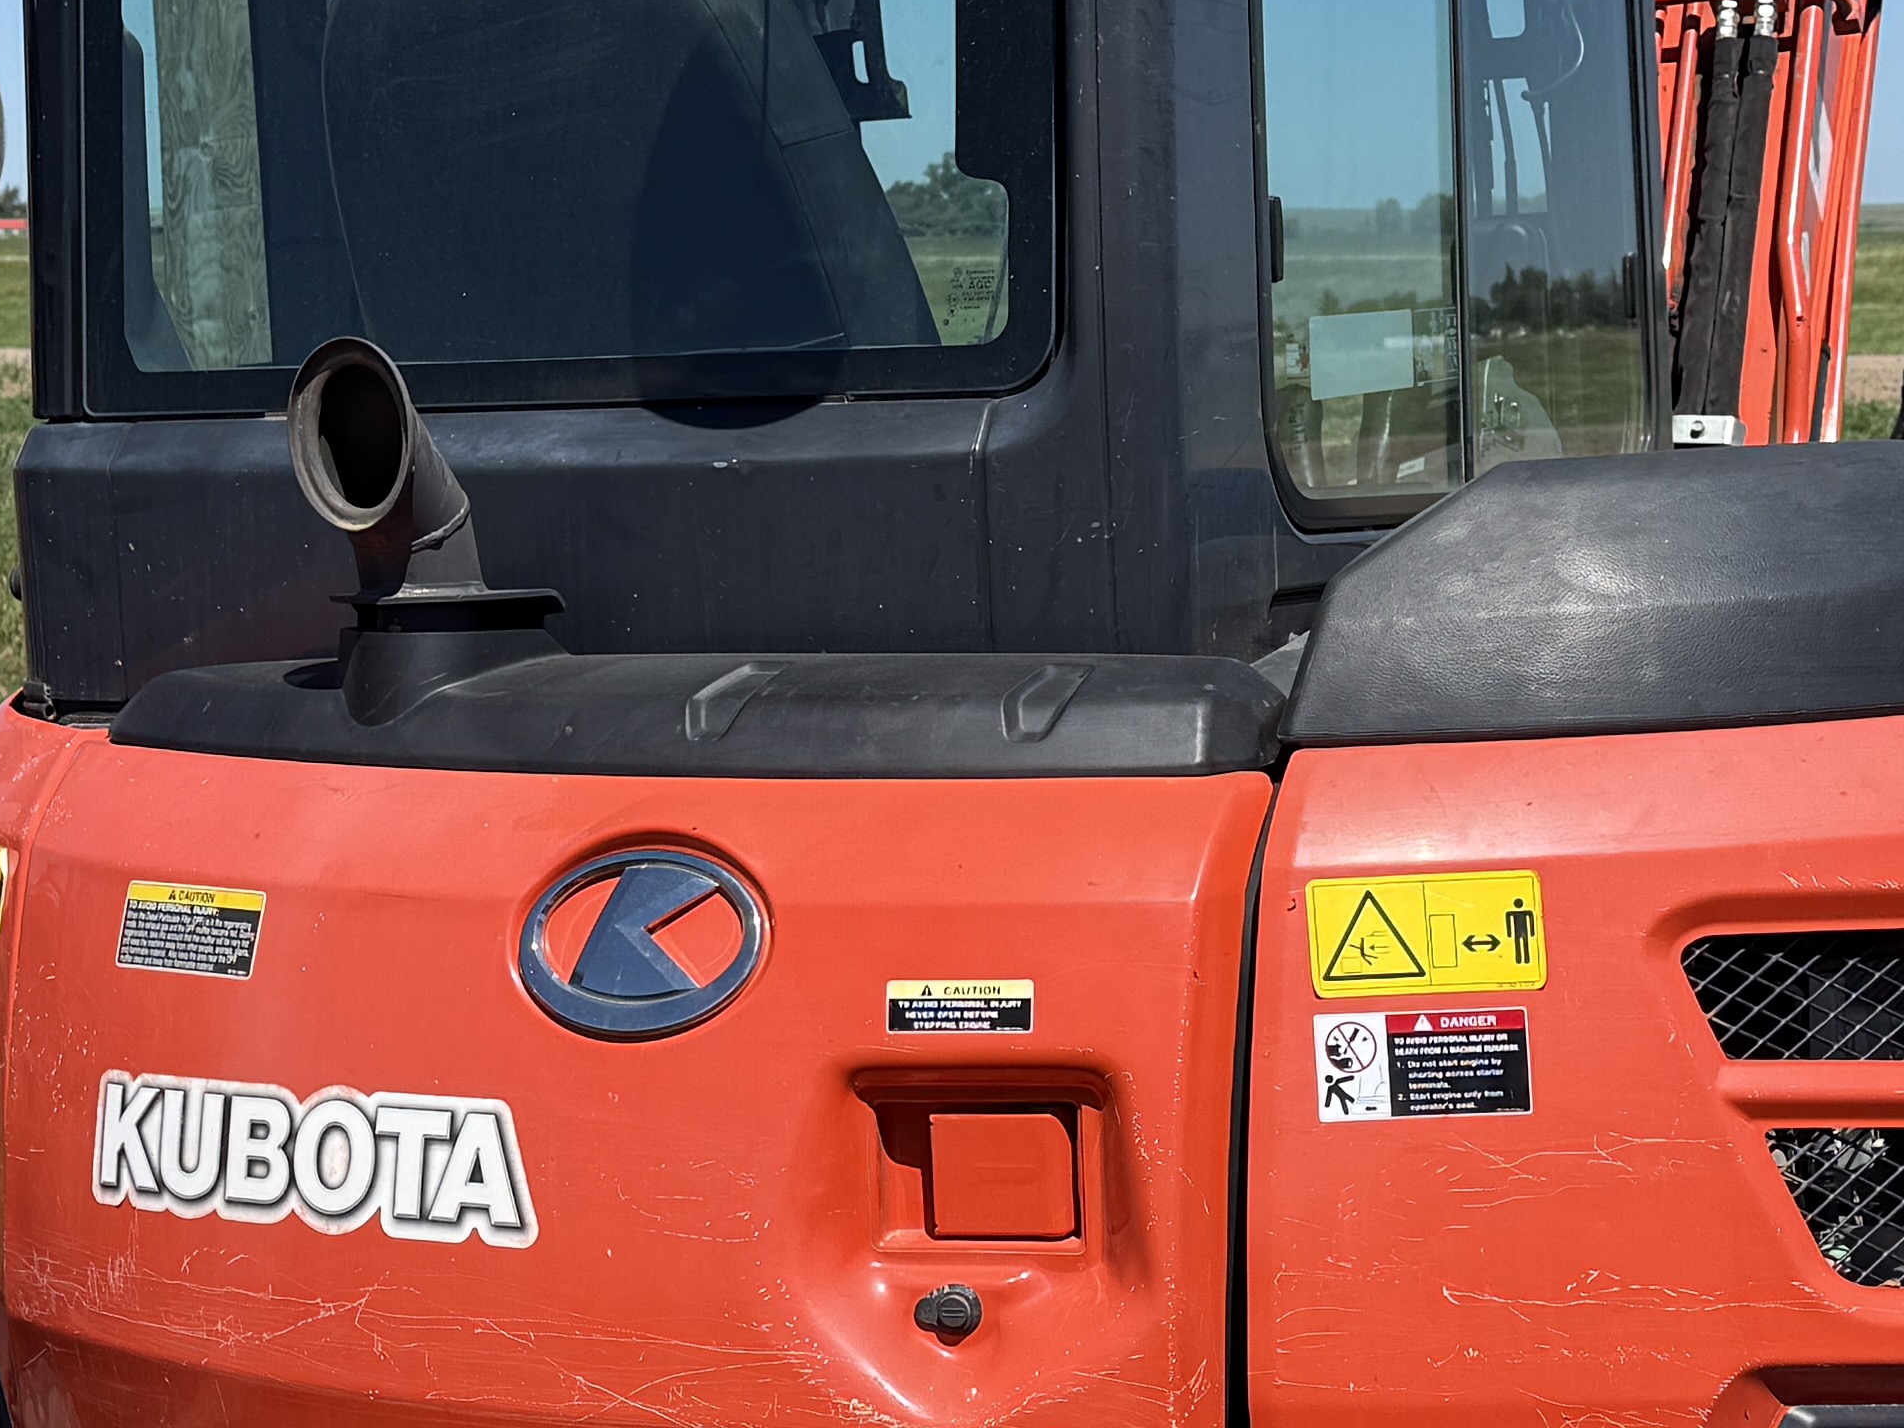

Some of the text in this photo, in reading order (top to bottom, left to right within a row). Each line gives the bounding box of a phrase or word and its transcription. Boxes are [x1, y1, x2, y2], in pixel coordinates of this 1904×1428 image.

[178, 890, 215, 903] CAUTION
[943, 986, 1001, 996] CAUTION
[1439, 1014, 1497, 1028] DANGER
[99, 1082, 522, 1229] KUBOTA
